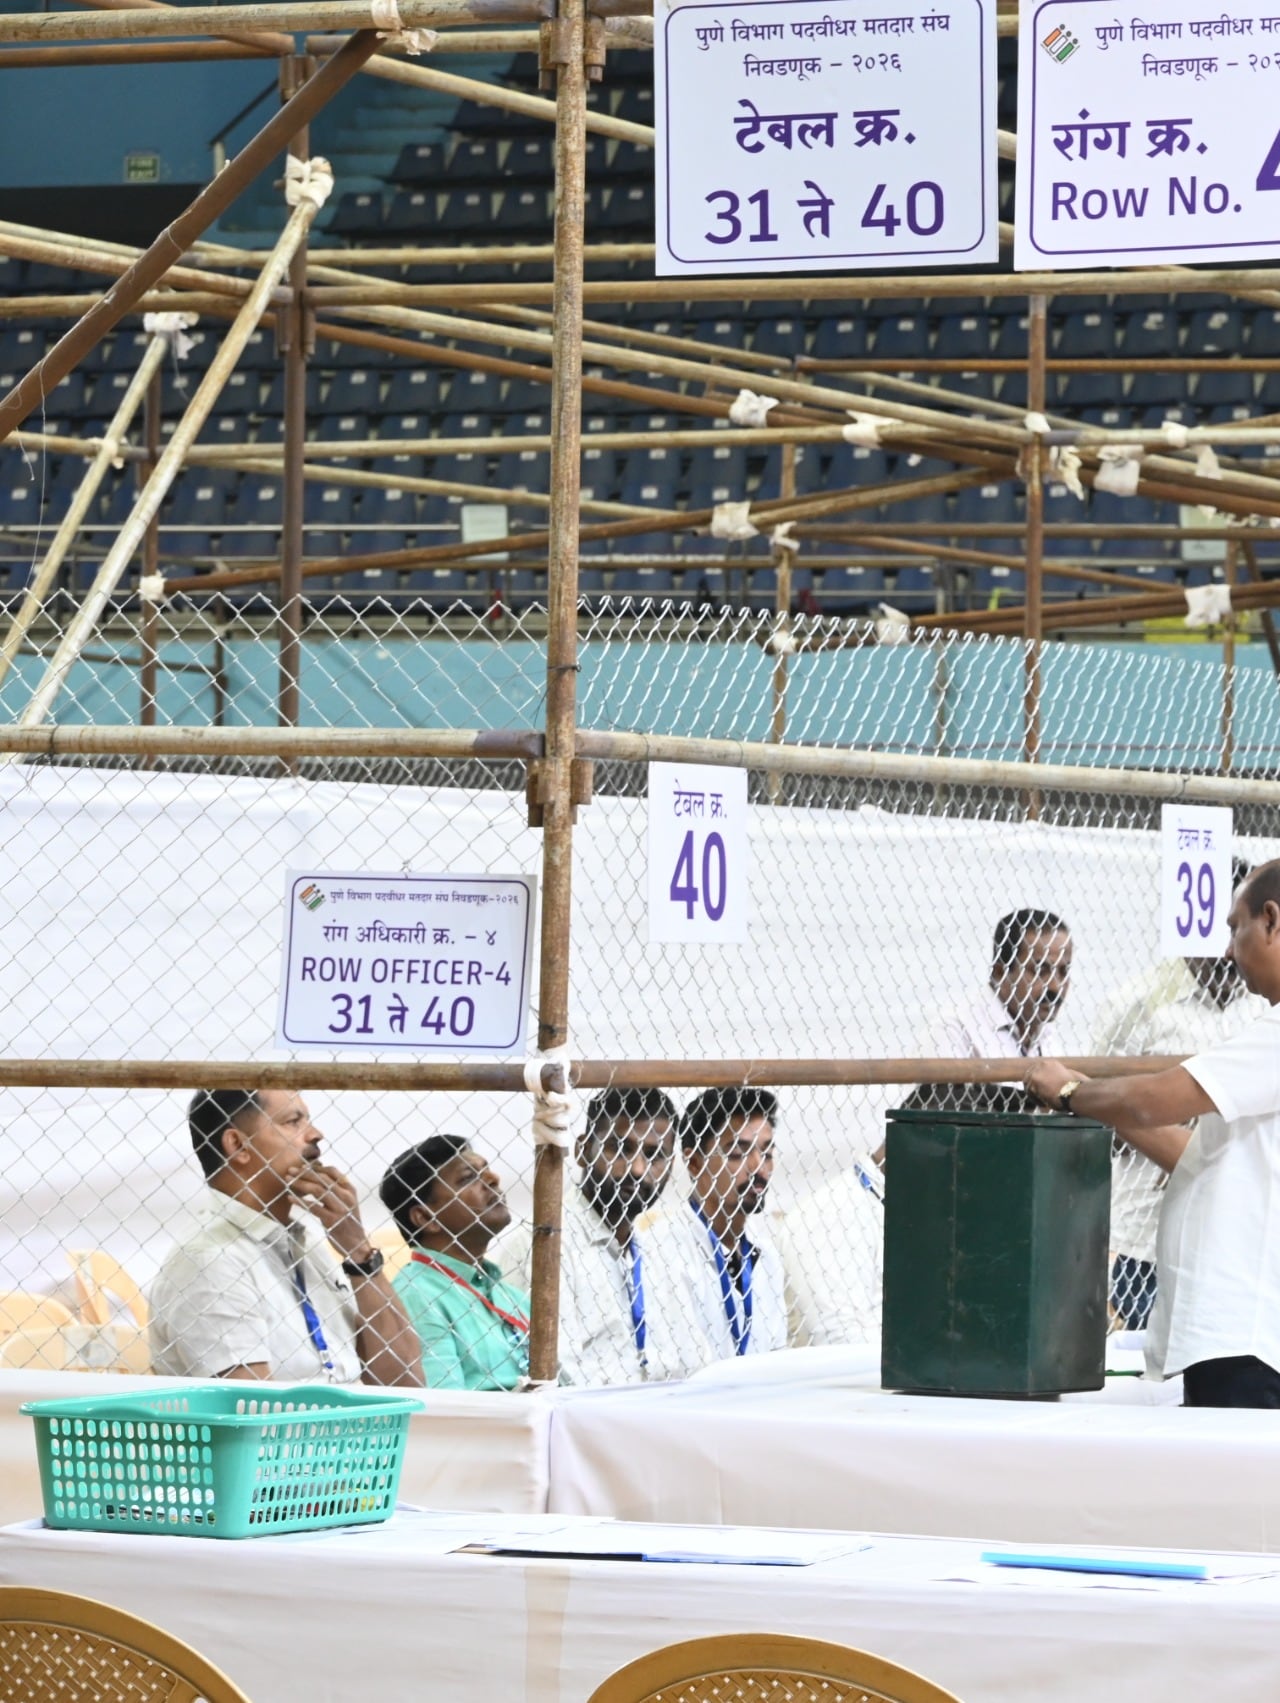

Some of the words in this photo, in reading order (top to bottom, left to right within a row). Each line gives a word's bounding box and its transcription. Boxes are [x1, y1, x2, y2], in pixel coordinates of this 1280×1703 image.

[696, 20, 724, 51] पुणे
[731, 19, 784, 42] विभाग
[791, 15, 856, 42] पदवीधर
[863, 17, 915, 37] मतदार
[920, 9, 950, 32] संघ
[1096, 19, 1123, 50] पुणे
[1131, 18, 1182, 42] विभाग
[1189, 14, 1252, 40] पदवीधर
[743, 54, 822, 81] निवडणूक
[852, 53, 902, 73] २०२६
[1142, 54, 1218, 80] निवडणूक
[733, 99, 838, 153] टेबल
[853, 109, 916, 148] क्र.
[1051, 108, 1131, 161] रांग
[1146, 118, 1208, 158] क्र.
[705, 189, 778, 244] 31
[797, 180, 835, 238] ते
[861, 181, 944, 237] 40
[1051, 182, 1149, 221] Row
[1169, 176, 1242, 216] No.
[670, 830, 727, 921] 40
[1176, 862, 1215, 938] 39
[323, 919, 348, 942] रांग
[356, 919, 427, 945] अधिकारी
[432, 928, 455, 945] क्र.
[485, 930, 497, 946] ४
[301, 956, 362, 983] ROW
[371, 958, 512, 986] OFFICER-4
[328, 993, 374, 1034] 31
[387, 992, 409, 1034] ते
[421, 995, 475, 1037] 40
